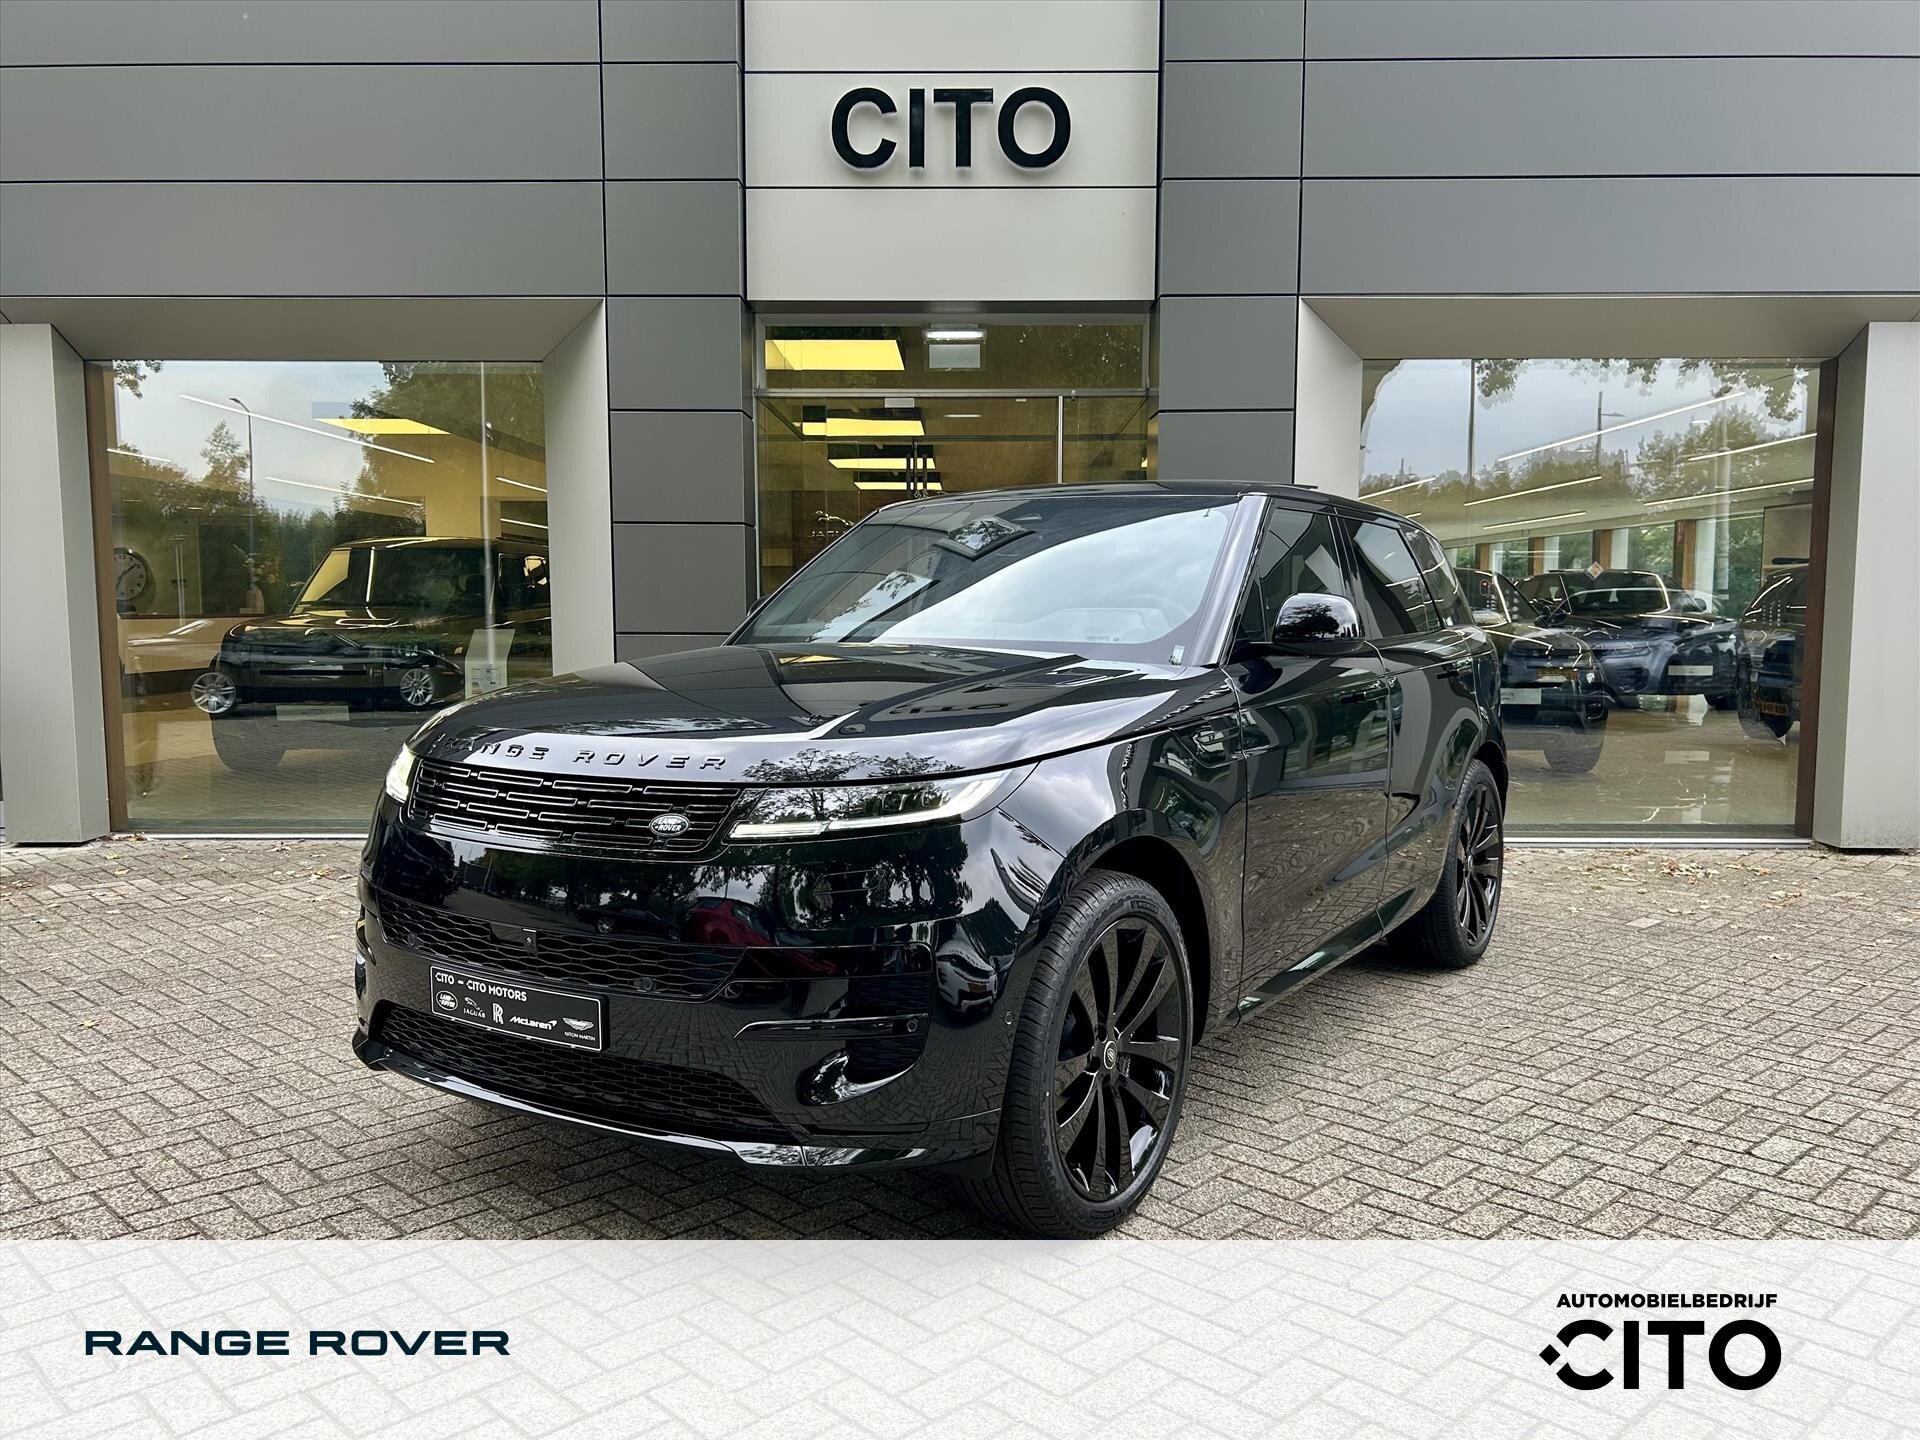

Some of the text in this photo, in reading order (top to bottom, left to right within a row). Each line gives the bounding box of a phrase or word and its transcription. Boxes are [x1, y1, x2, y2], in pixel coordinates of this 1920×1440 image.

[831, 87, 1071, 168] CITO
[572, 750, 727, 771] ROVER
[435, 971, 455, 985] CITO
[466, 979, 487, 993] CITO
[488, 985, 528, 1002] MOTORS
[463, 1007, 486, 1019] JAGUAR
[509, 1015, 553, 1031] McLaren
